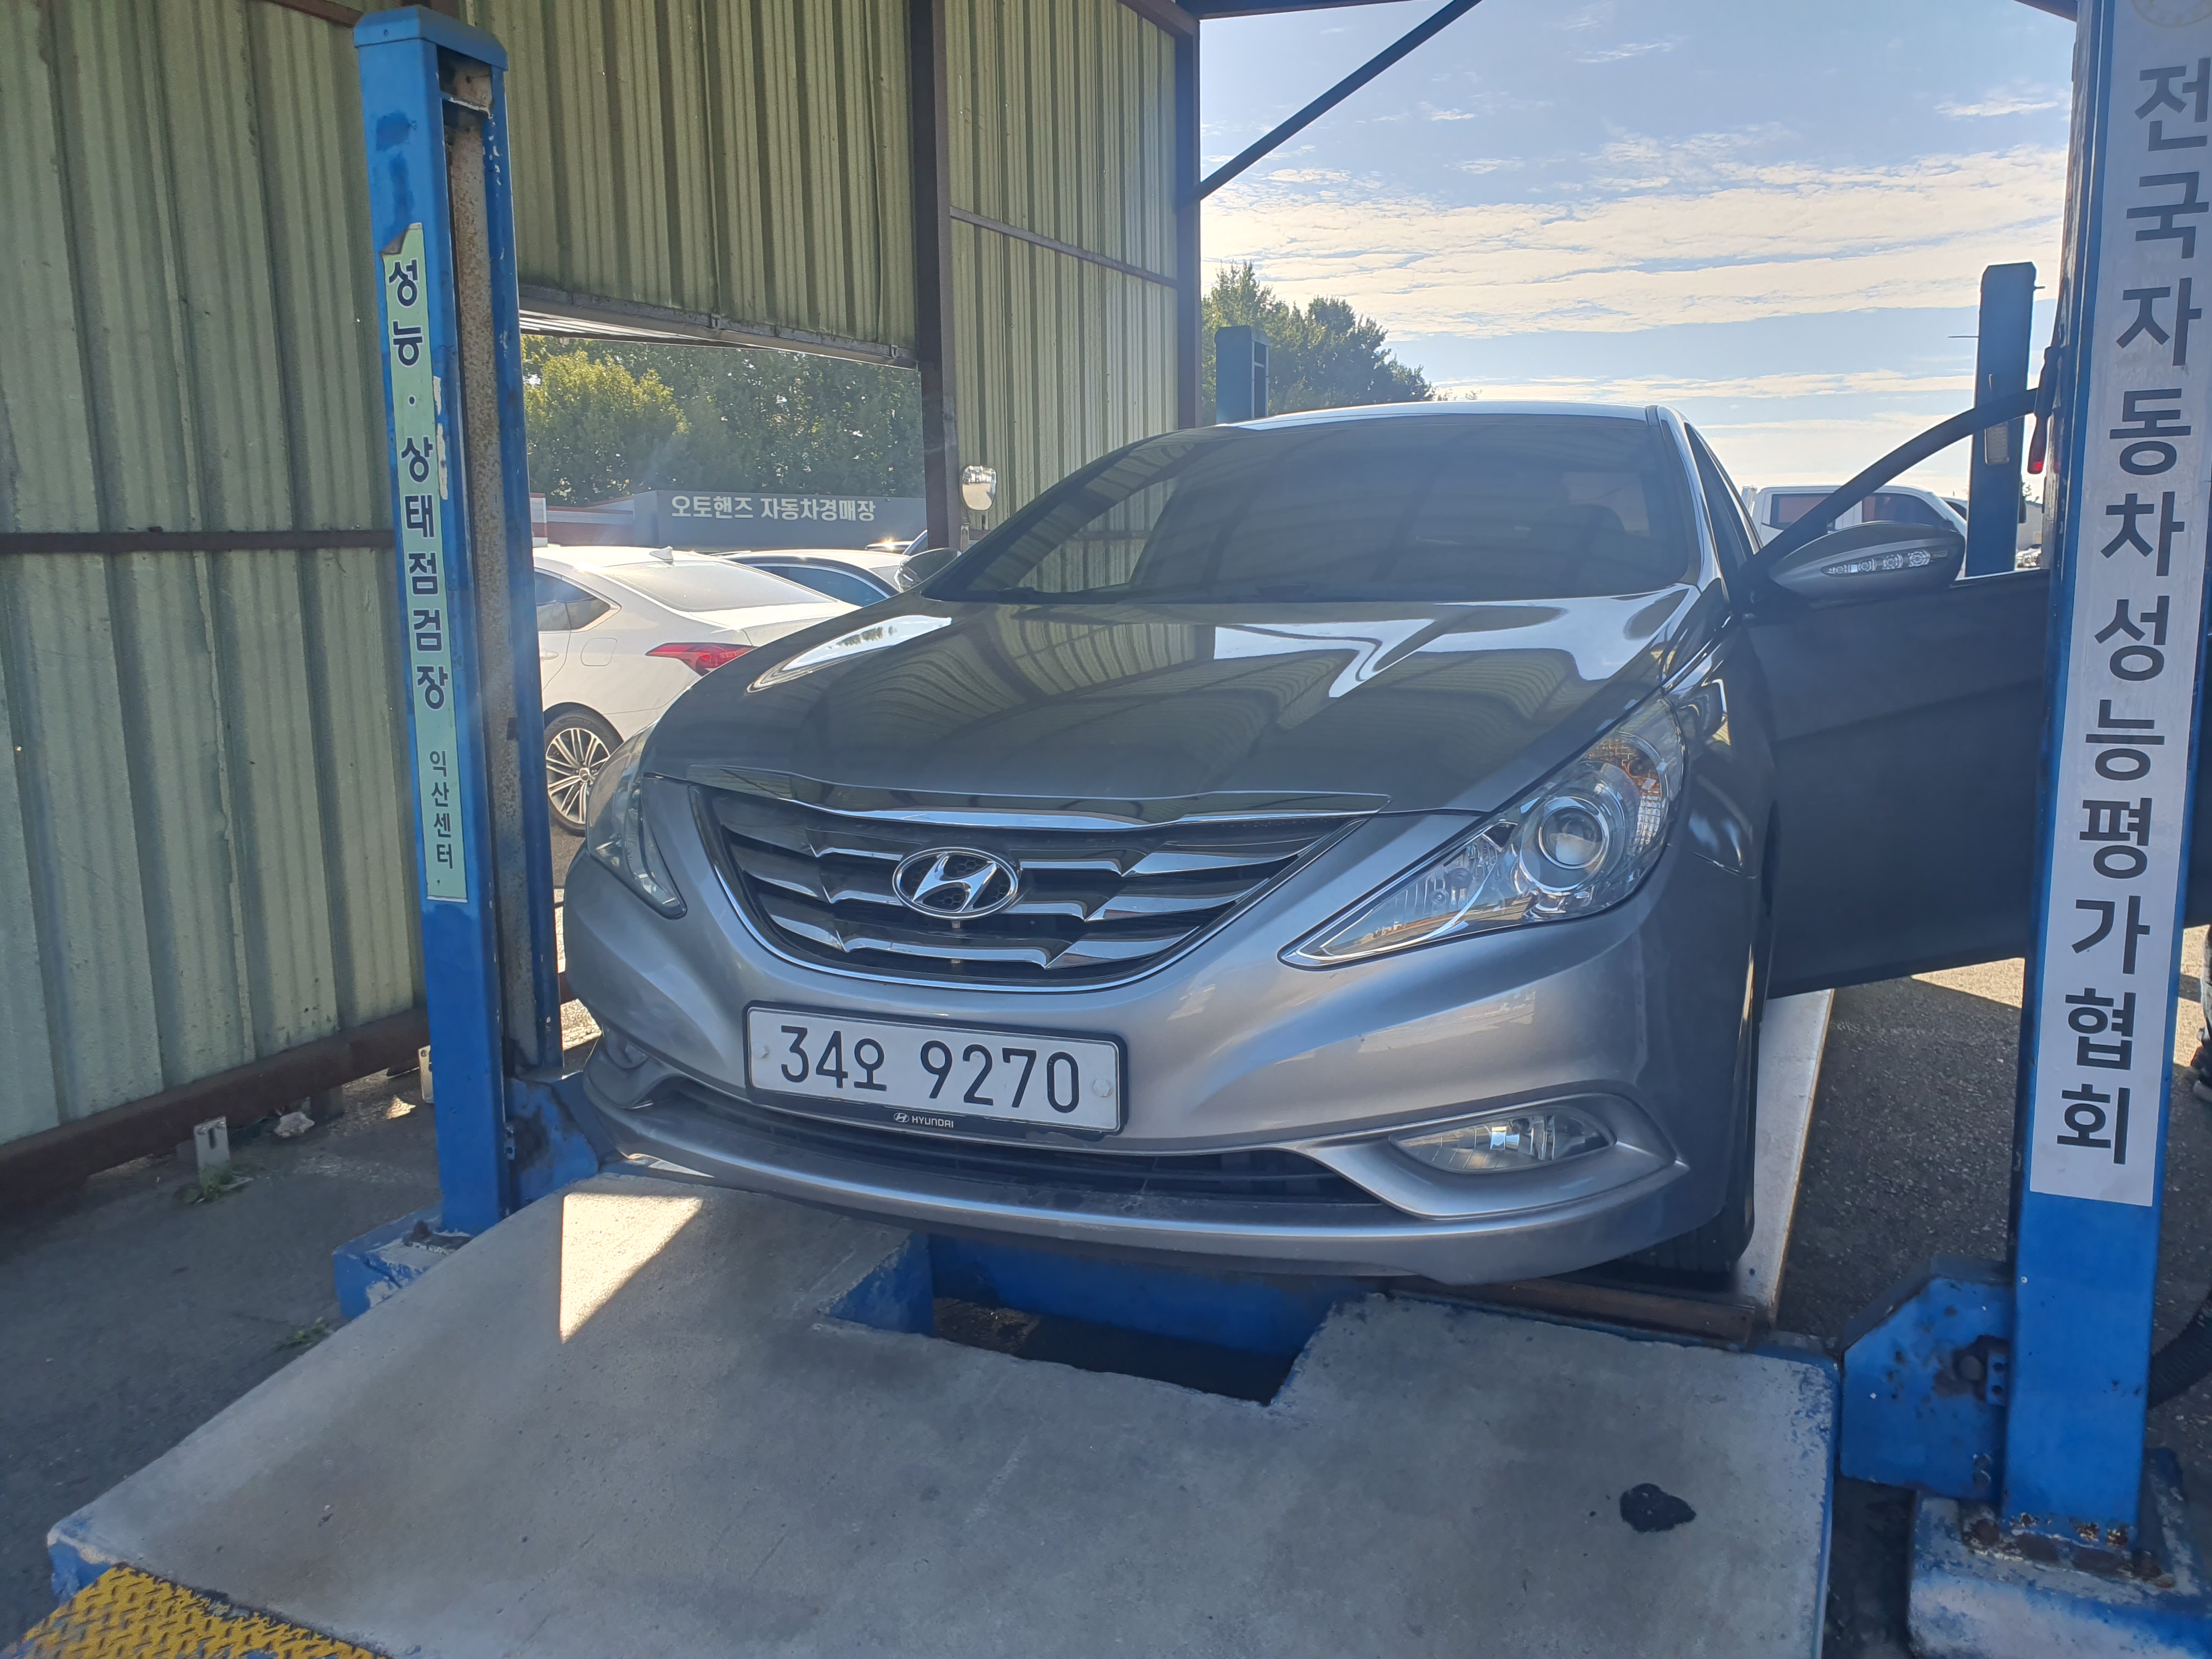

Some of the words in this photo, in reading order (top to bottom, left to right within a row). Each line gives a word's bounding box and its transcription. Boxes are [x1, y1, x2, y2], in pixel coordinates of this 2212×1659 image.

[672, 495, 753, 518] 오토핸즈
[760, 498, 876, 522] 자동차경매장
[430, 751, 453, 869] 익산센터
[781, 1025, 887, 1091] 34오
[920, 1040, 1079, 1114] 9270
[912, 1115, 953, 1128] HYUNDAI
